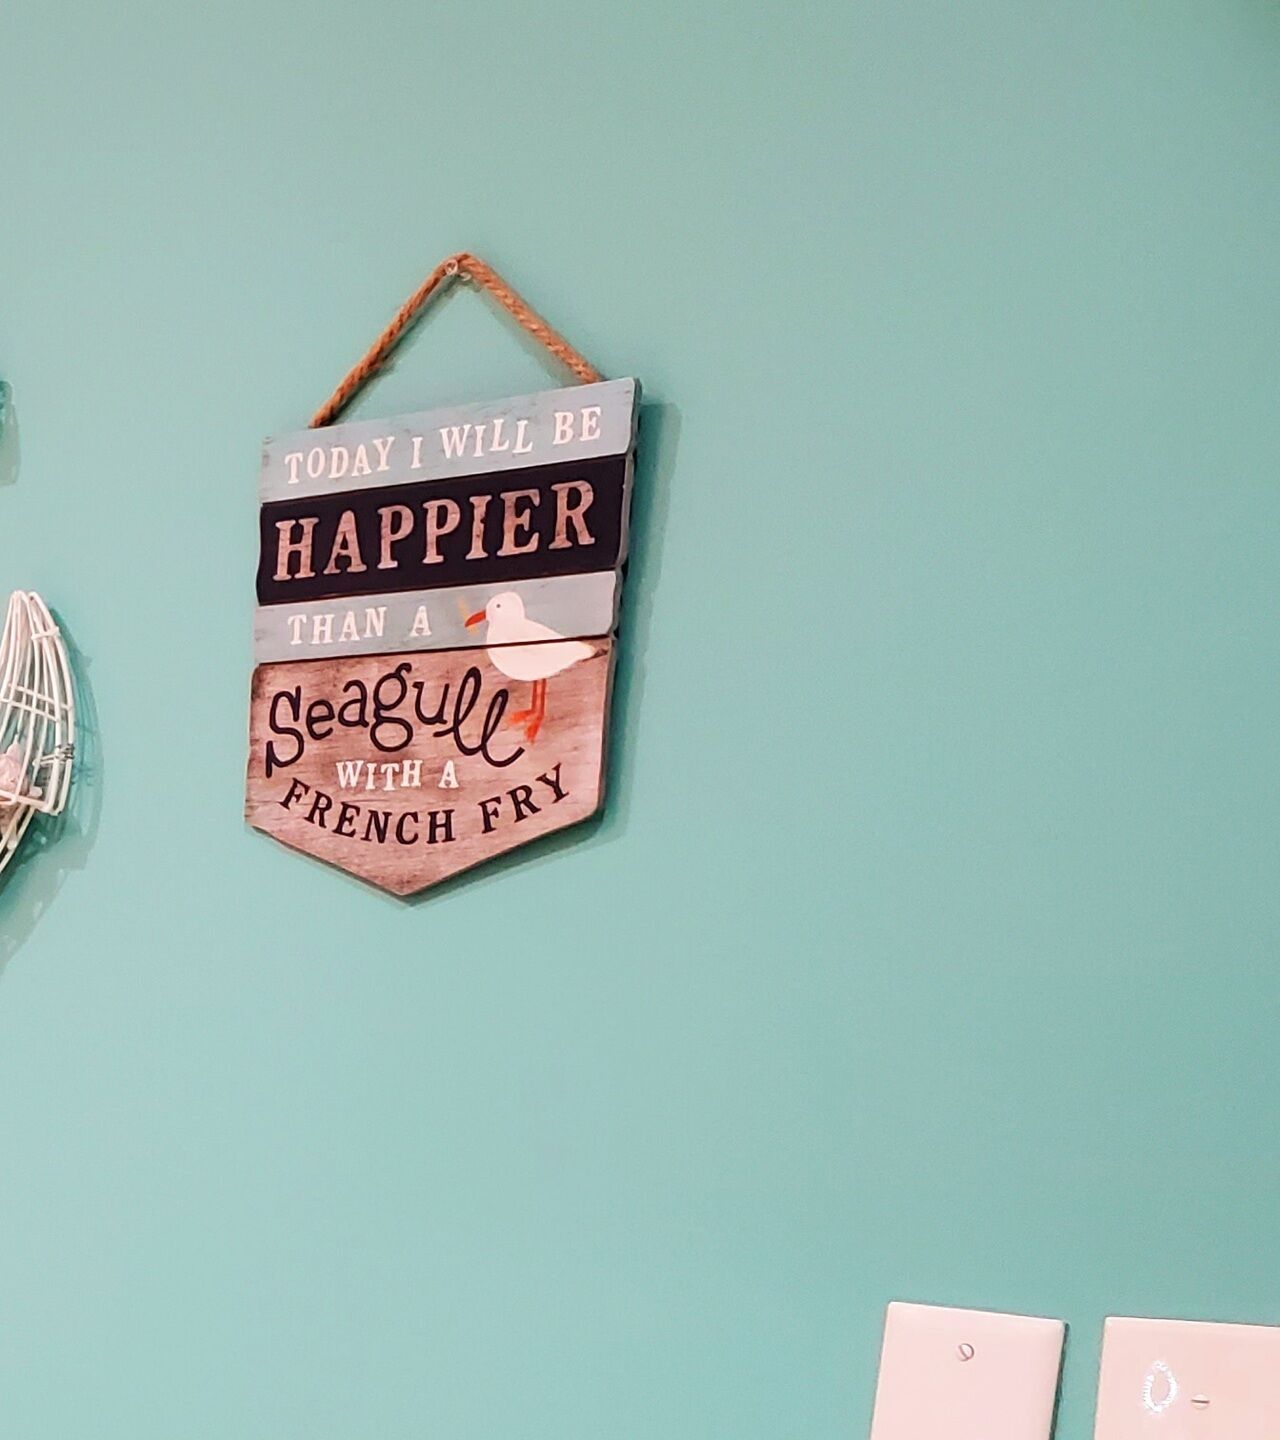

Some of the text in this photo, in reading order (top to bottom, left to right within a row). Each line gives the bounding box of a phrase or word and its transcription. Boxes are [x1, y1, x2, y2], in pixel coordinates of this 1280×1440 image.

[285, 406, 601, 485] TODAY I WILL BE
[273, 478, 596, 582] HAPPIER
[287, 605, 432, 645] THAN A
[265, 662, 525, 778] Seagull
[280, 764, 570, 846] FRENCH FRY
[337, 759, 459, 790] WITH A
